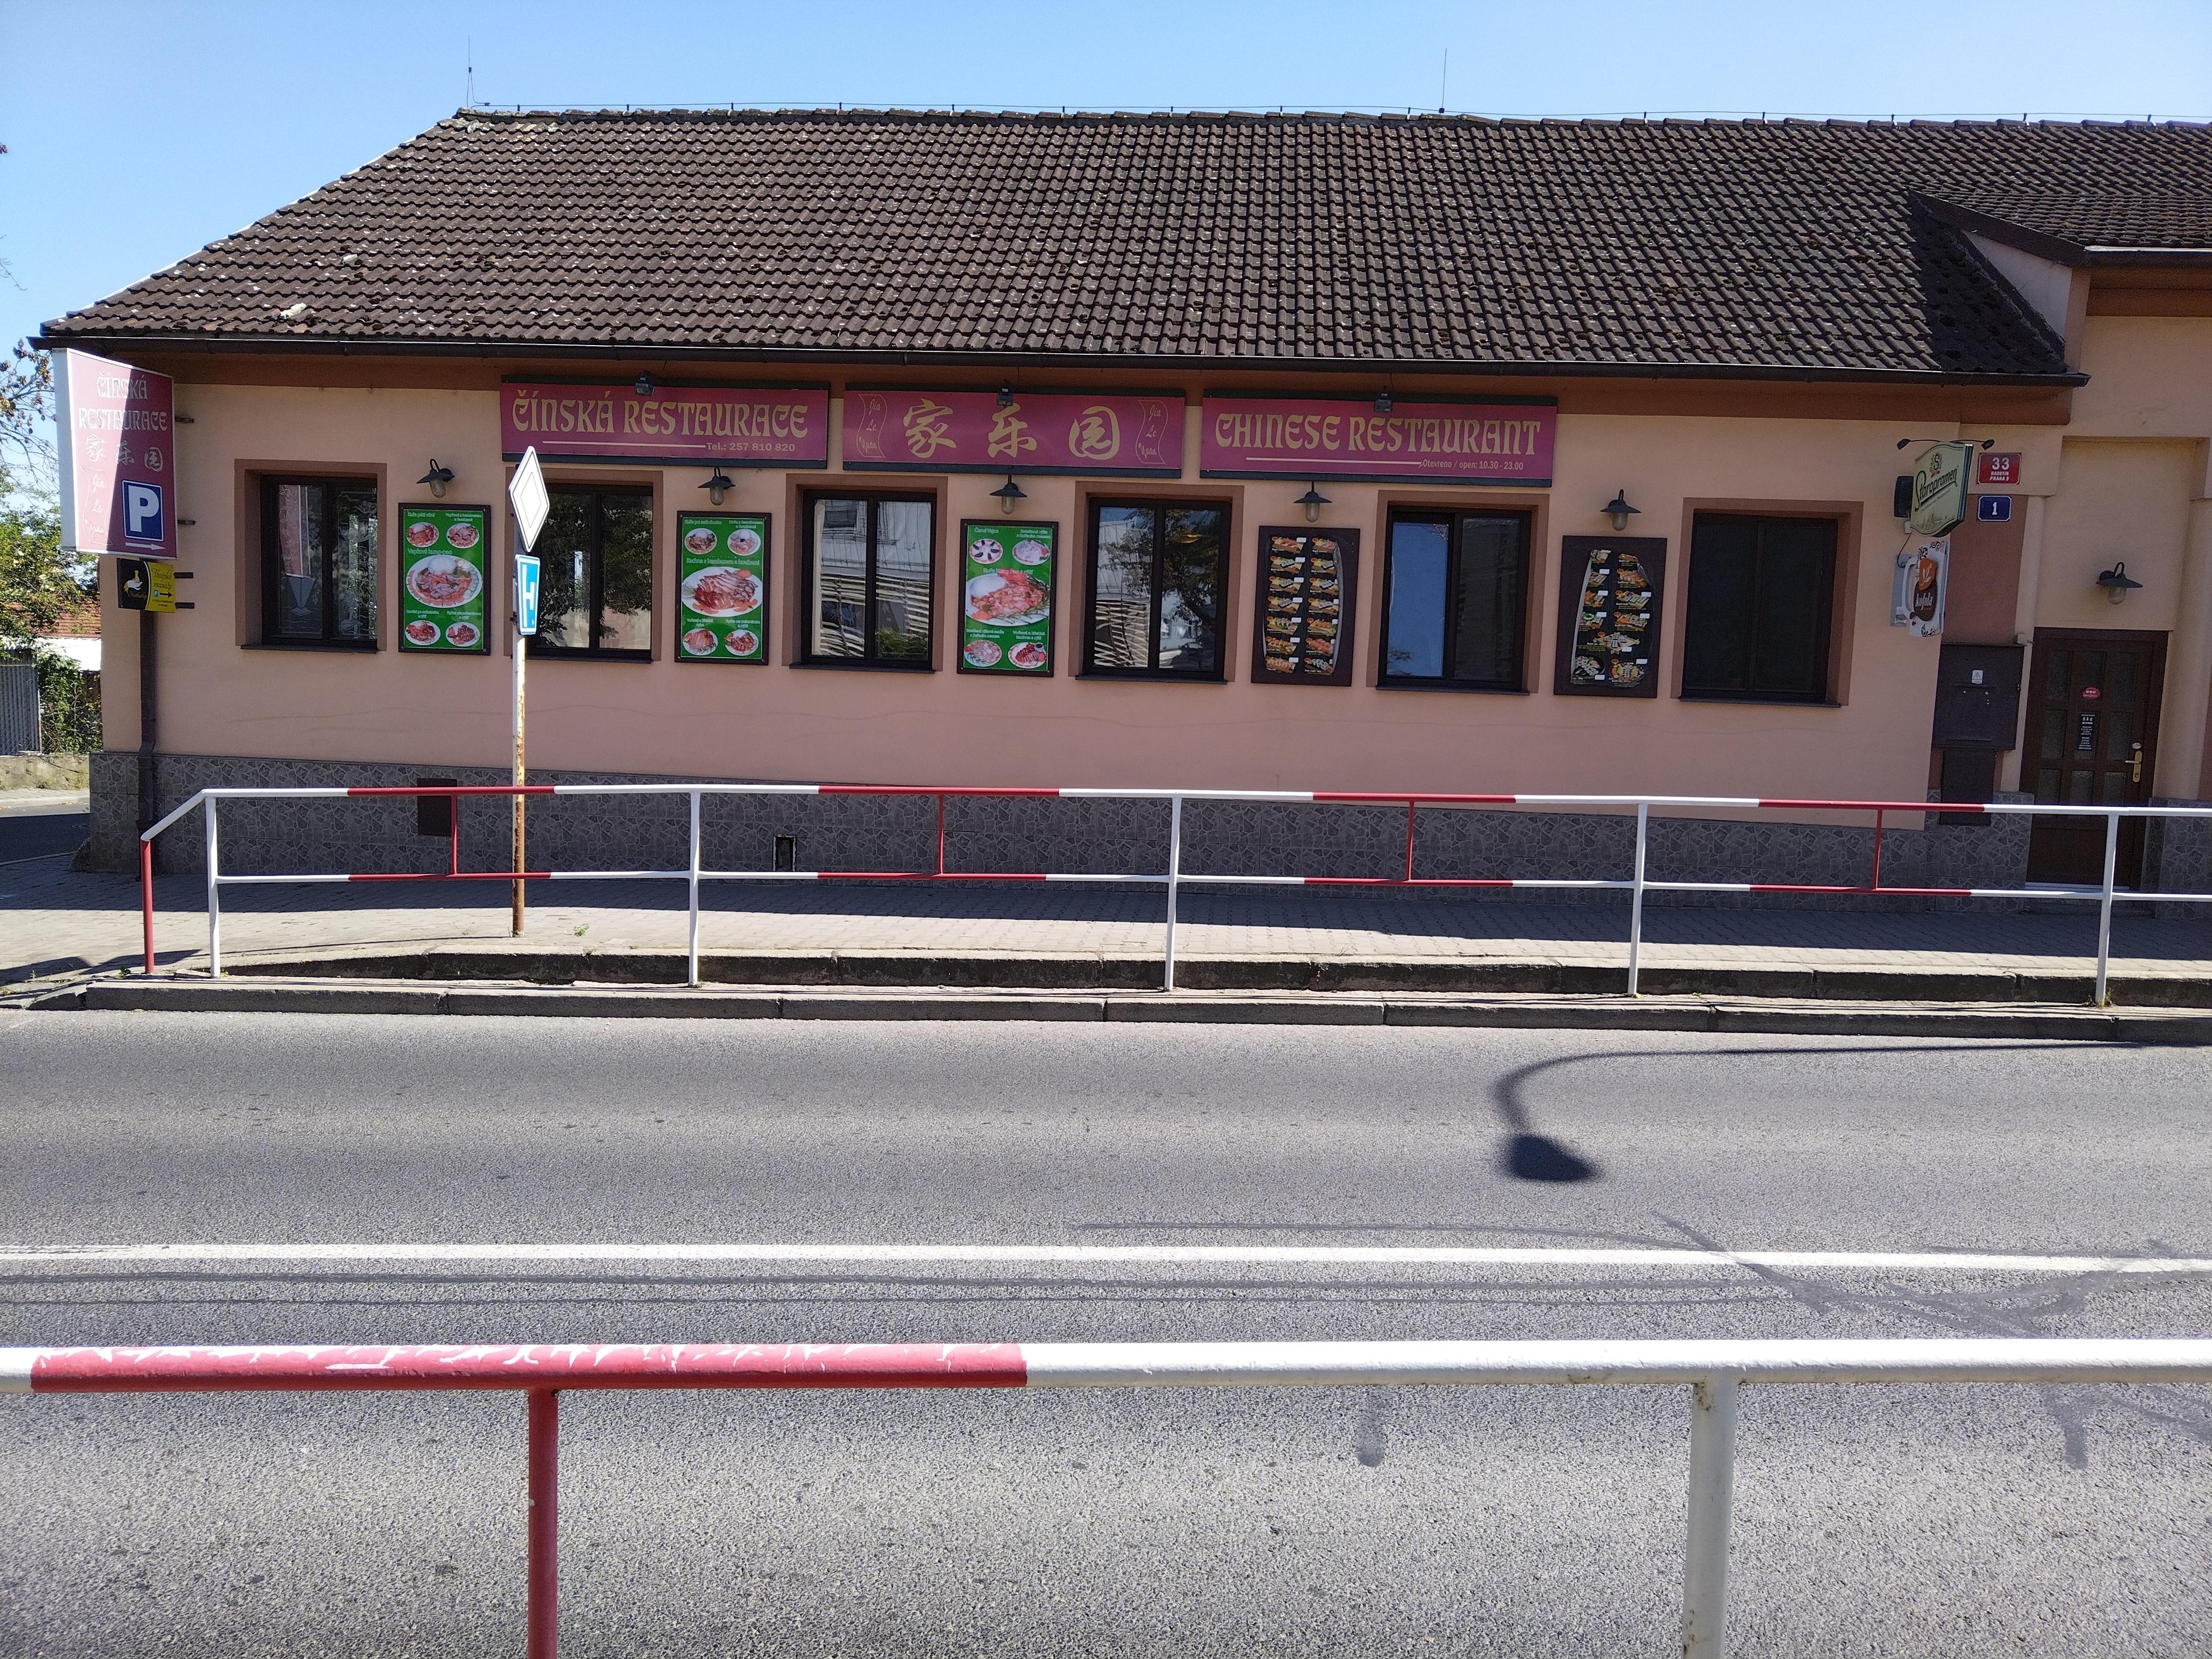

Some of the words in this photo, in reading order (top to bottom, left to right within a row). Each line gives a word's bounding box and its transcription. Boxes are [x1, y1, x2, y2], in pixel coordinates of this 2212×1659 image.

[97, 371, 147, 400] ČÍNSKÁ
[868, 398, 881, 412] Jia
[1149, 403, 1162, 418] Jia
[78, 407, 168, 431] RESTAURACE
[512, 389, 615, 434] ČÍNSKÁ
[624, 400, 809, 439] RESTAURACE
[1215, 413, 1341, 451] CHINESE
[1348, 416, 1541, 456] RESTAURANT
[706, 442, 726, 451] Tel.:
[729, 443, 748, 451] 257
[752, 443, 772, 451] 810
[774, 443, 796, 452] 820
[1459, 461, 1477, 471] open:
[1479, 461, 1498, 470] 10.30
[1503, 462, 1523, 470] 23.00
[1992, 457, 2009, 470] 33
[1914, 468, 1958, 512] Staropramen
[1992, 501, 1998, 515] 1
[1915, 592, 1933, 610] kofola
